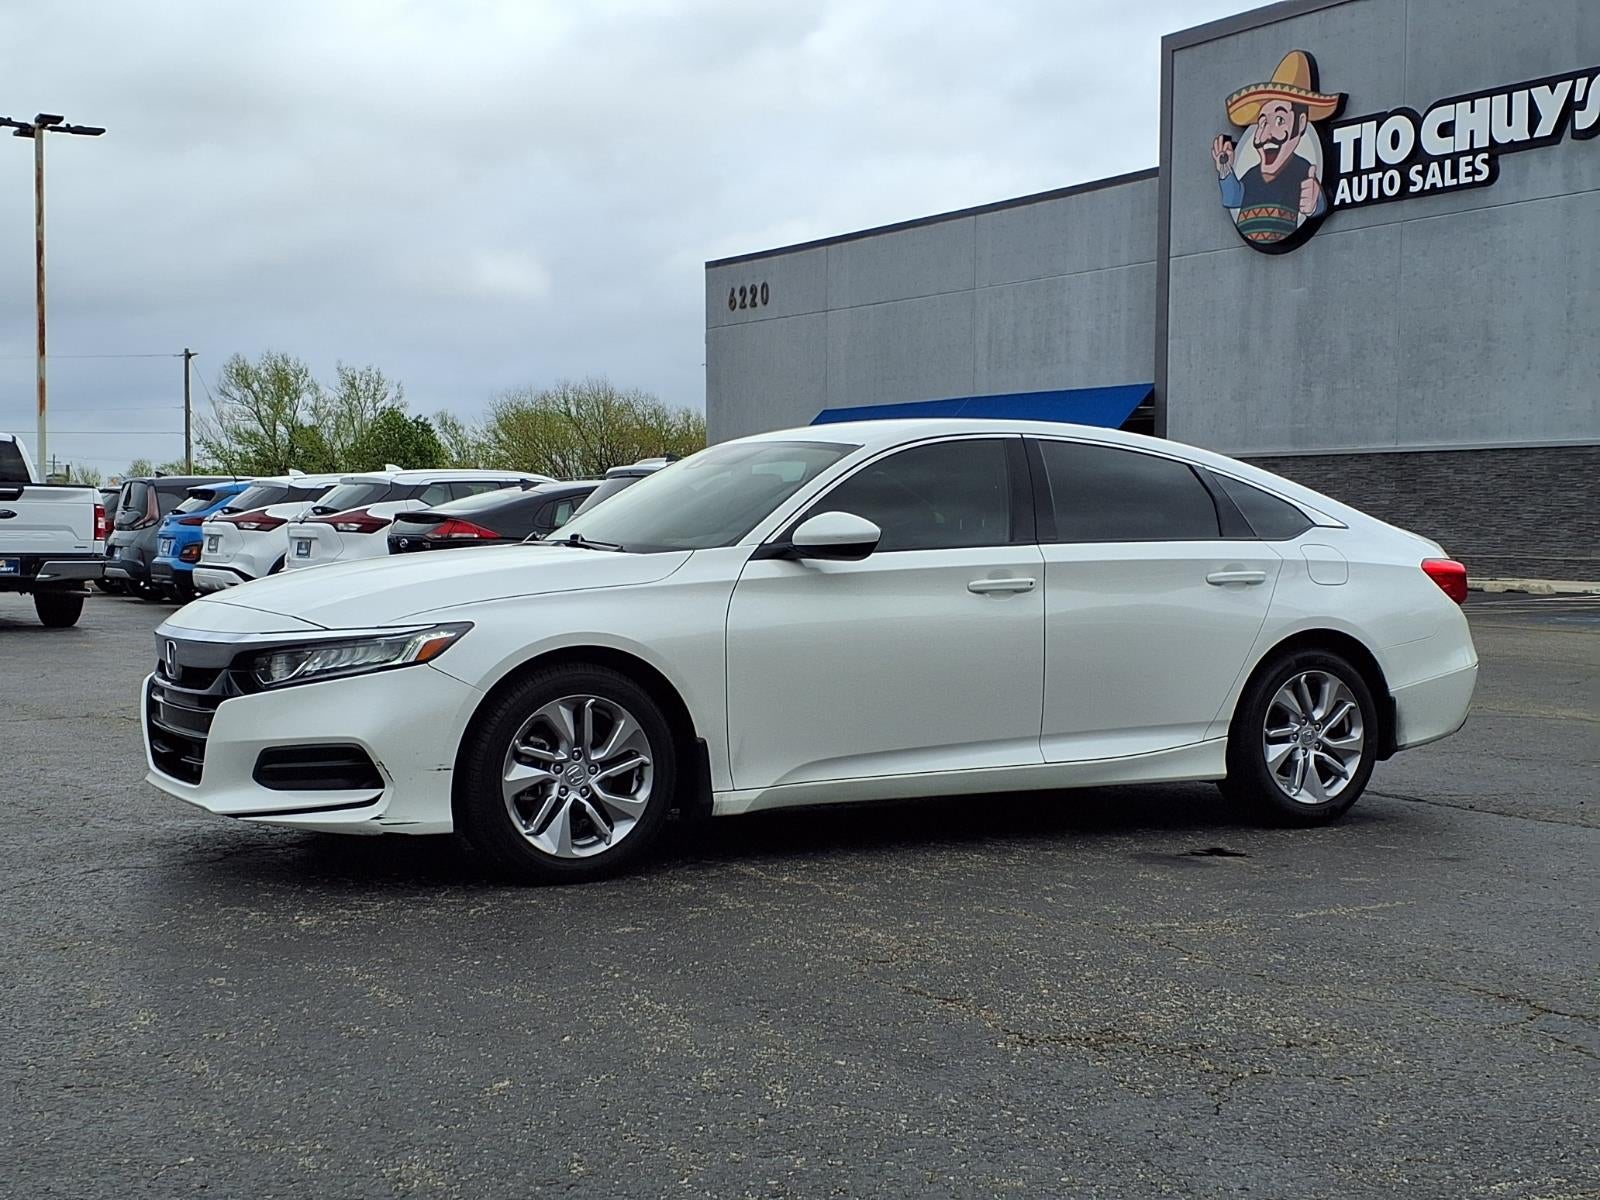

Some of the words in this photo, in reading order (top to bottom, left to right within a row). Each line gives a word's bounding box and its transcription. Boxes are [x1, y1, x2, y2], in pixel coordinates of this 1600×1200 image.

[1333, 114, 1415, 174] TIO
[1334, 169, 1401, 206] AUTO
[1409, 152, 1490, 193] SALES
[728, 281, 769, 312] 6220
